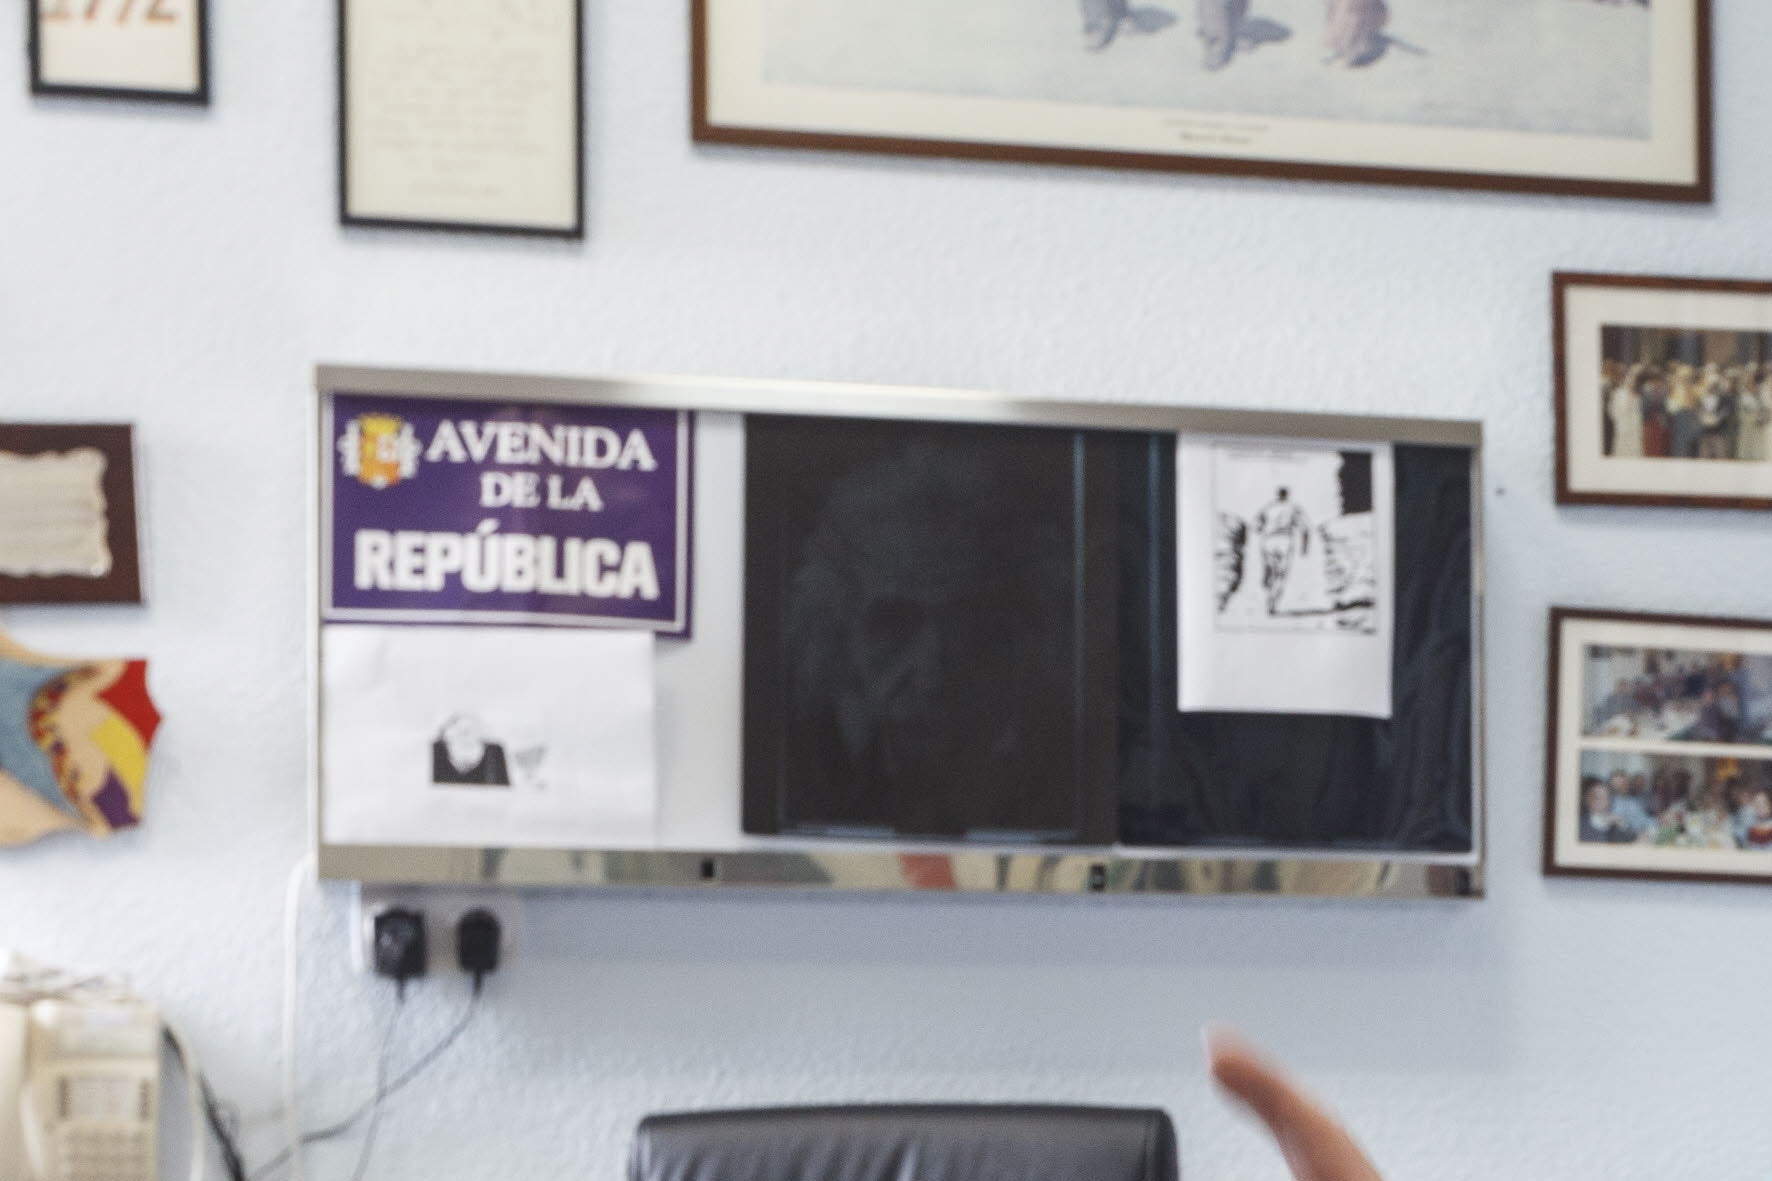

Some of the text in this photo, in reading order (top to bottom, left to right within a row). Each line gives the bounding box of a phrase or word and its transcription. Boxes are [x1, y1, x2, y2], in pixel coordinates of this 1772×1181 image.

[426, 419, 657, 471] AVENIDA
[479, 472, 604, 512] DE LA
[354, 518, 660, 600] REPÚBLICA
